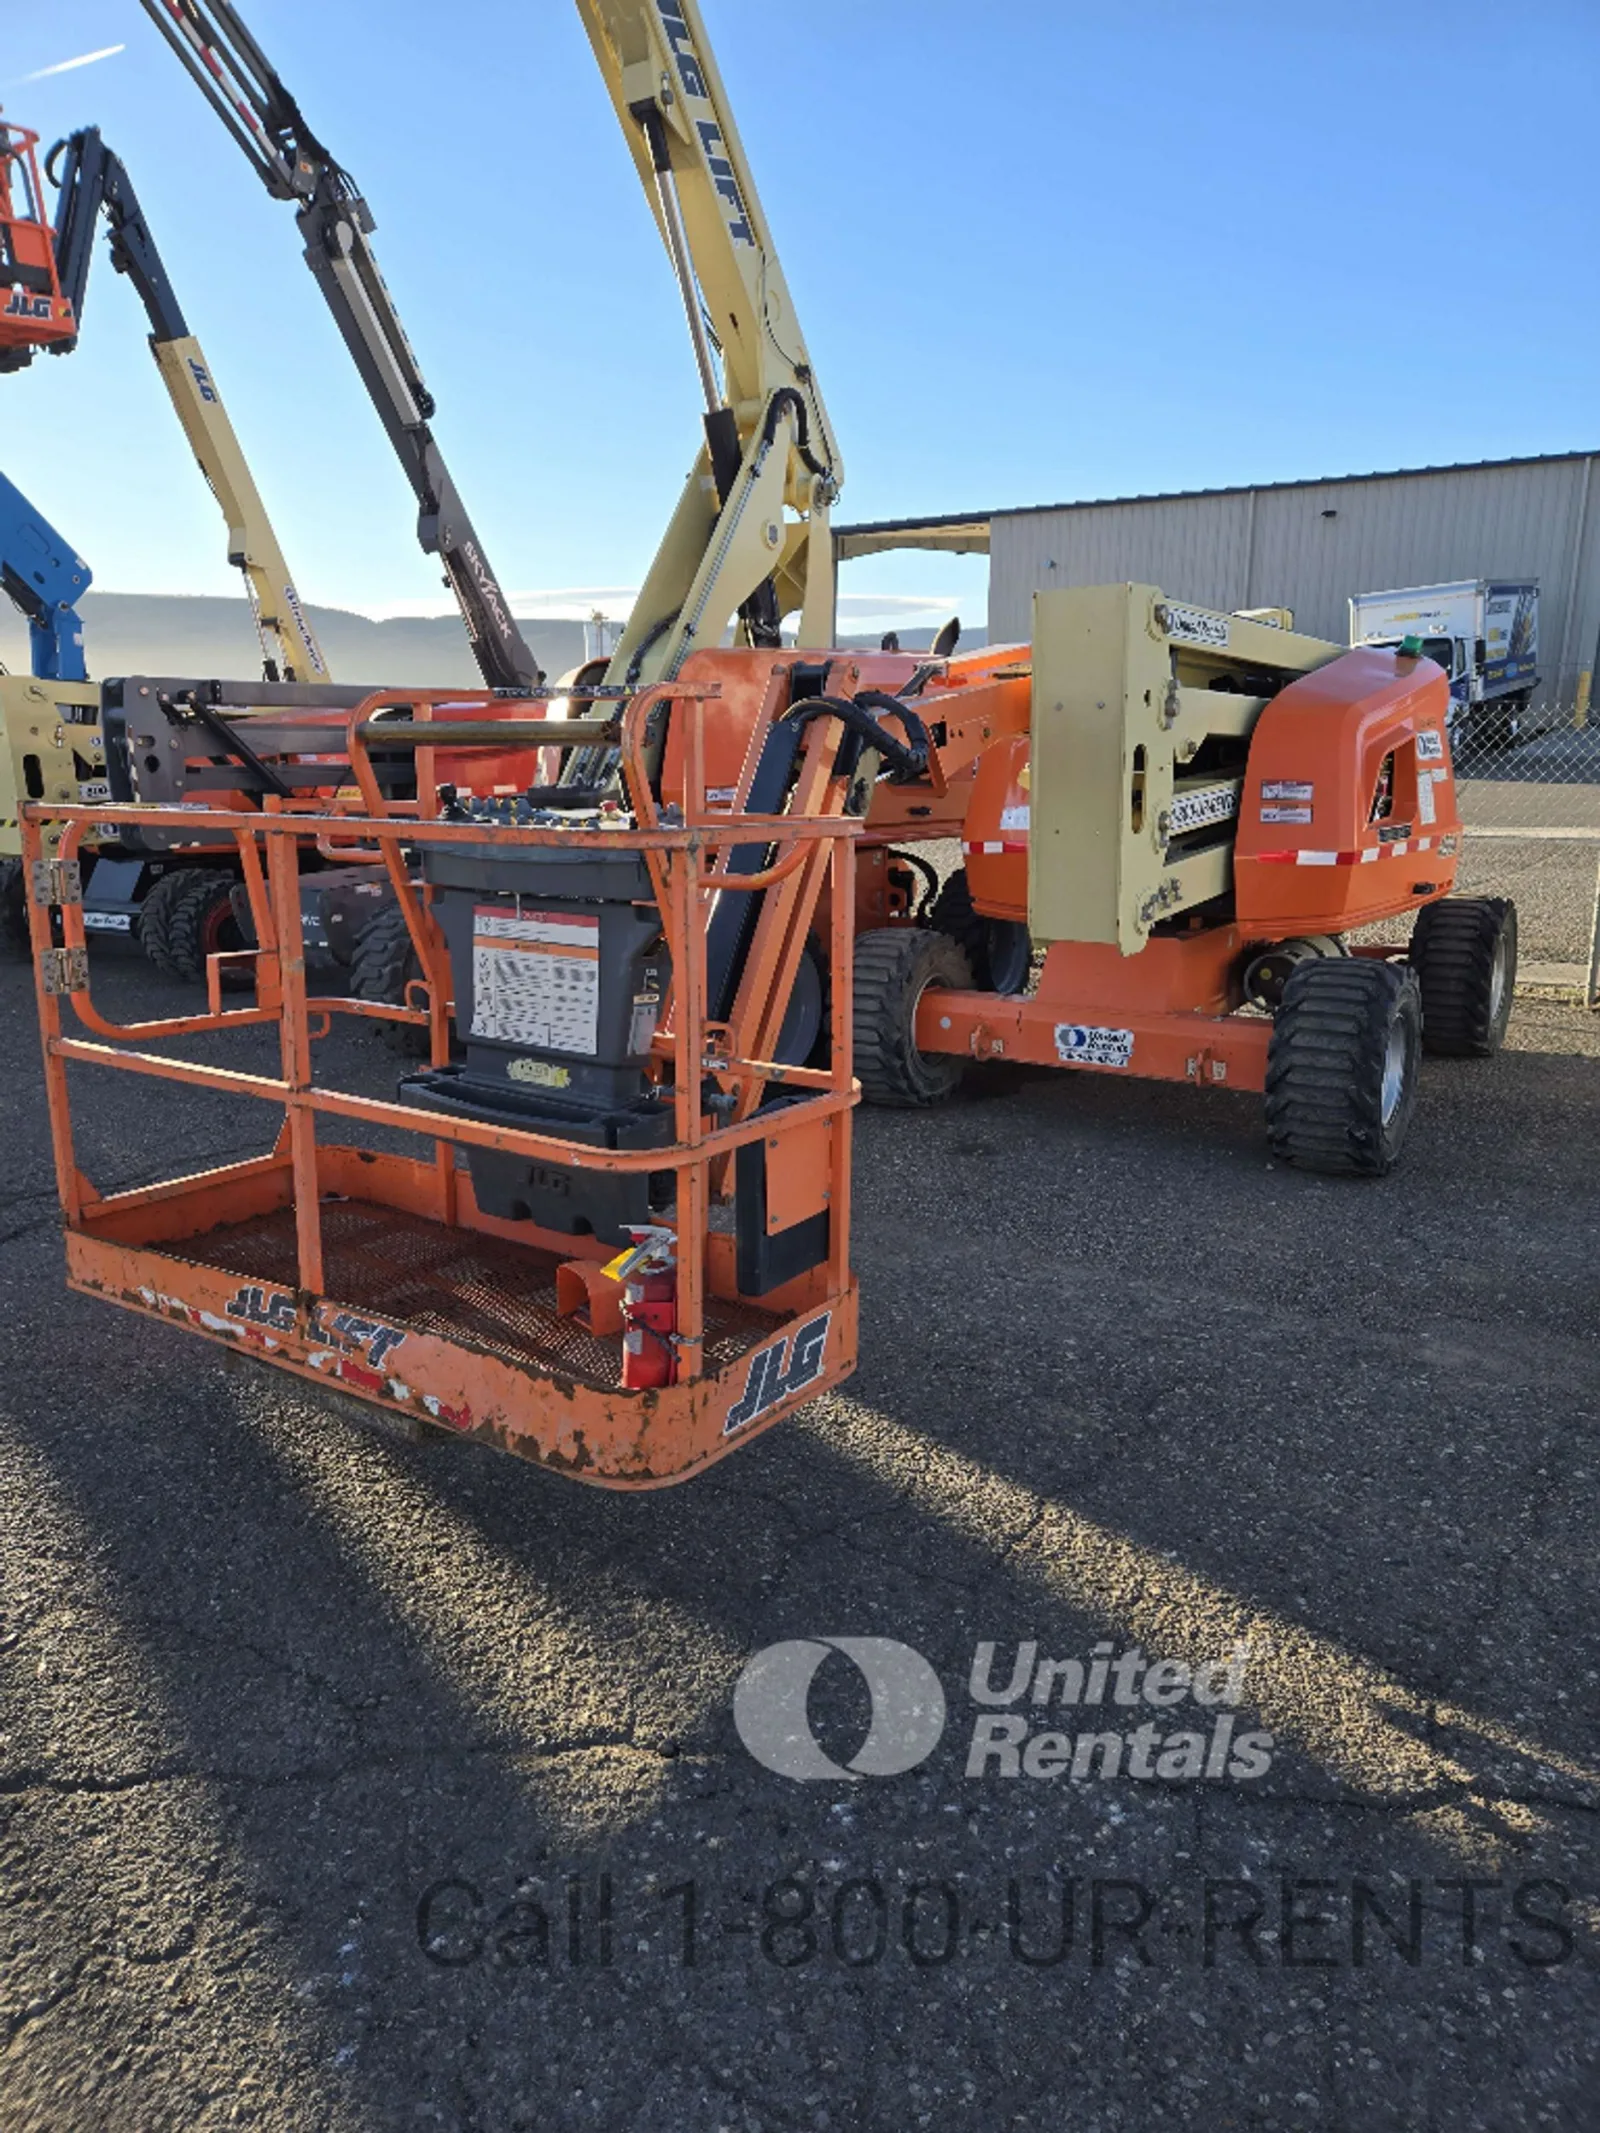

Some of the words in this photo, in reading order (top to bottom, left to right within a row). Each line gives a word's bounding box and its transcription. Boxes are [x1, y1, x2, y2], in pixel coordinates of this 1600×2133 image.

[696, 120, 756, 248] LIFT
[4, 293, 53, 319] JLG
[187, 357, 217, 403] JLG
[225, 1284, 297, 1334] JLG
[723, 1310, 833, 1436] JLG
